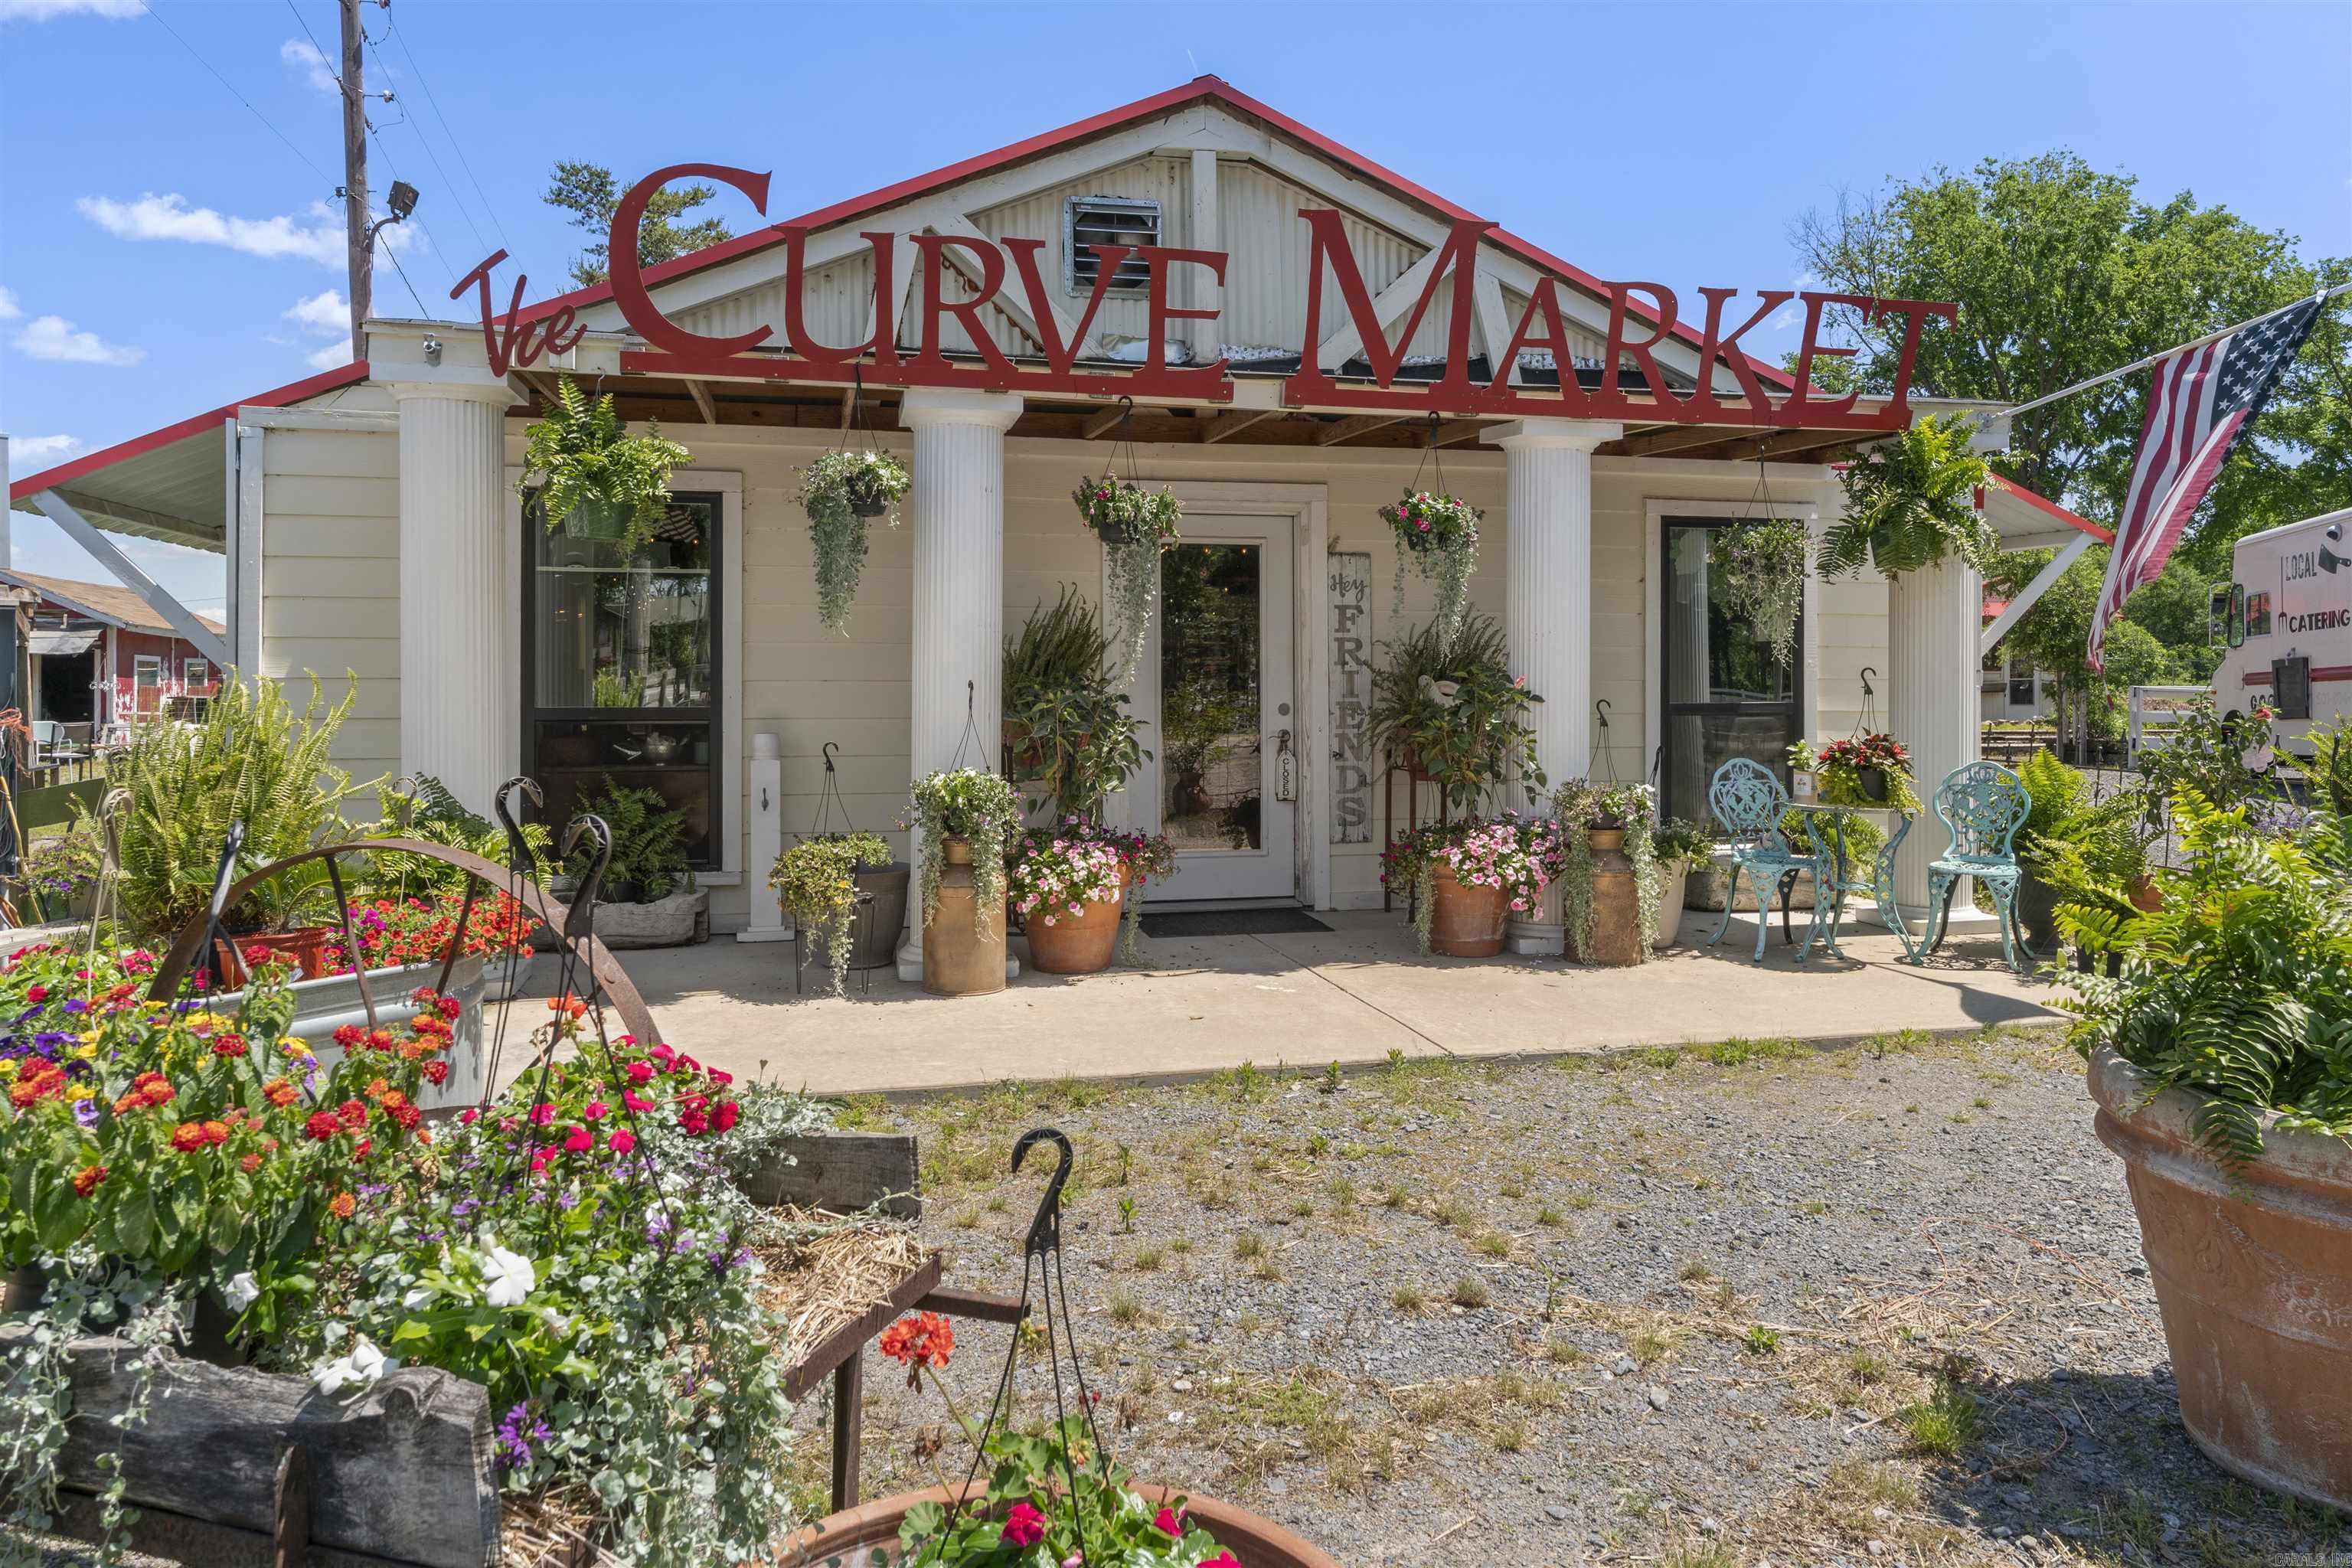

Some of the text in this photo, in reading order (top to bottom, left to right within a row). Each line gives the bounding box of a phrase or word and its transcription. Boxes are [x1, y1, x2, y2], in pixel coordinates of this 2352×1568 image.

[450, 163, 1958, 416] The CURVE MARKET
[2285, 551, 2317, 581] LOCAL
[1330, 573, 1369, 603] Hey
[2289, 609, 2350, 633] CATERING
[1334, 605, 1366, 827] FRIENDS
